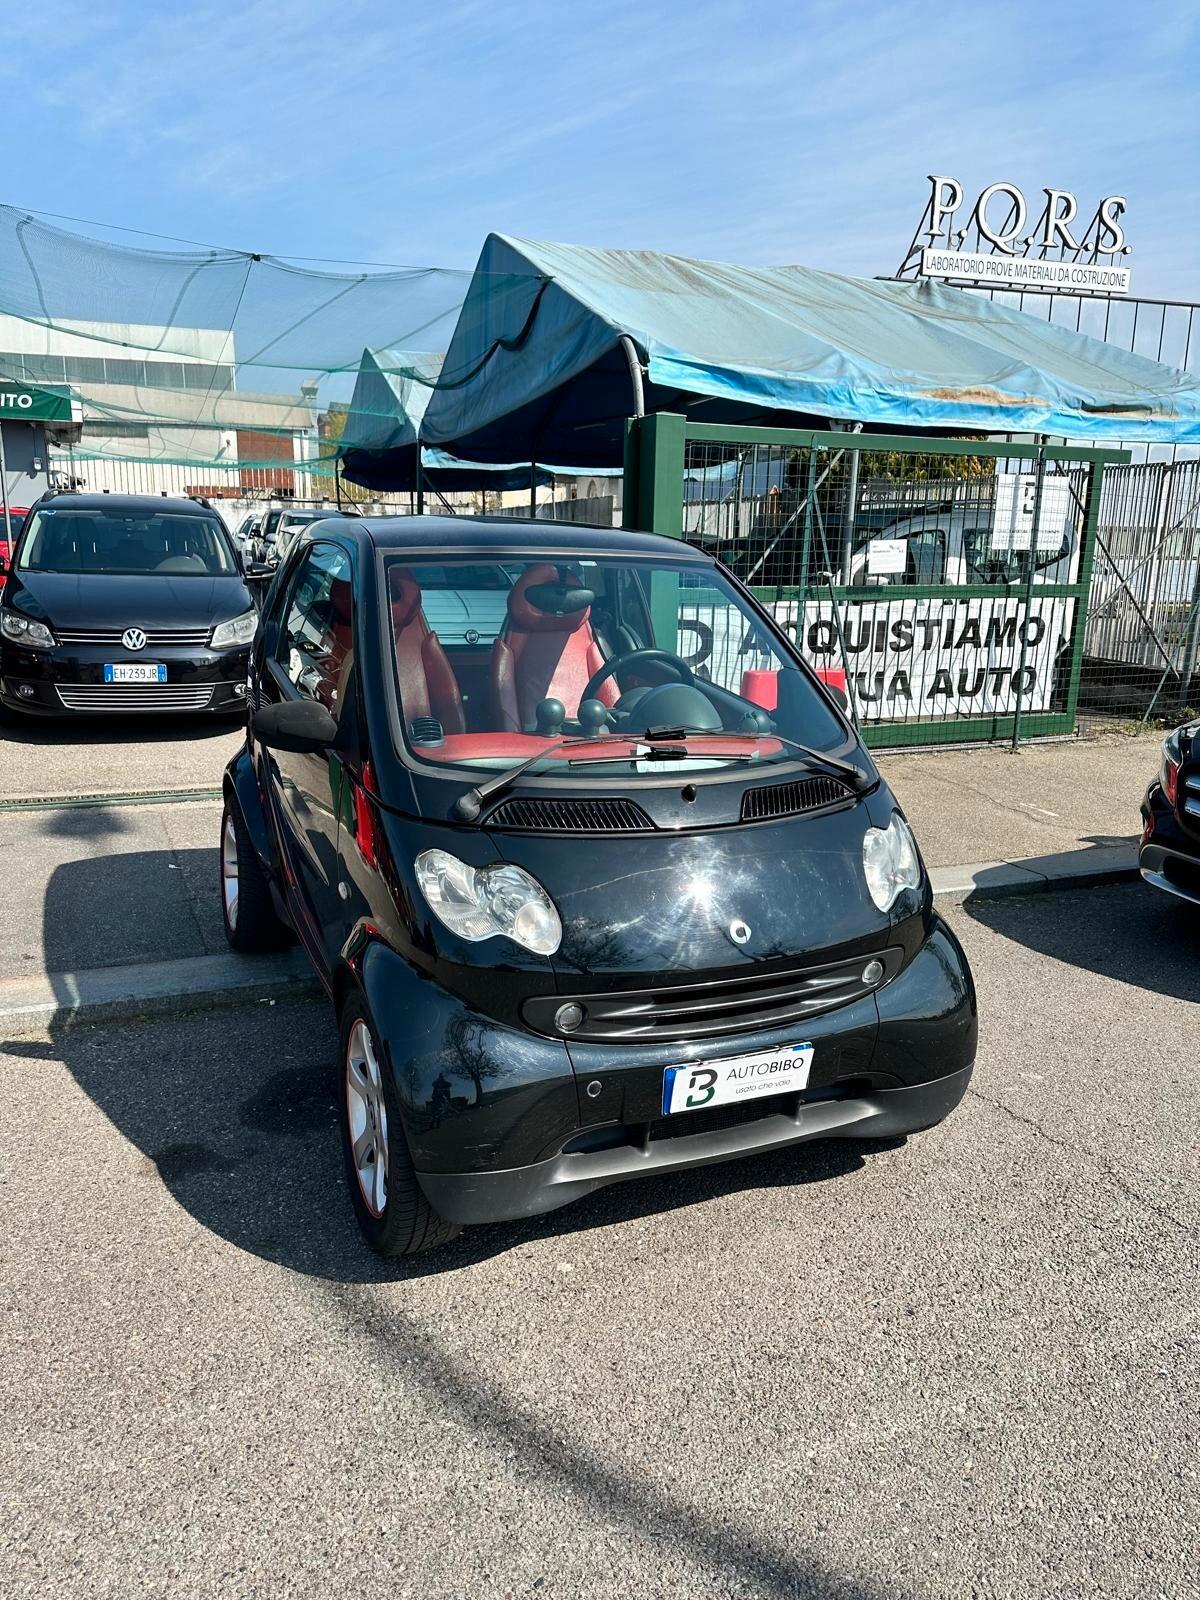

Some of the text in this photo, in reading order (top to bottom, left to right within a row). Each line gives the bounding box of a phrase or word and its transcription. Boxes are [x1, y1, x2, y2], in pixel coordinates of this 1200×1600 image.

[924, 175, 1132, 255] P.Q.R.S.
[925, 255, 1127, 288] LABORATORIO PROVE MATERIALI DA COSTRUZIONE
[848, 665, 1038, 702] UA AUTO
[726, 1057, 804, 1081] AUTOBIBO
[735, 1079, 791, 1095] usato che vale
